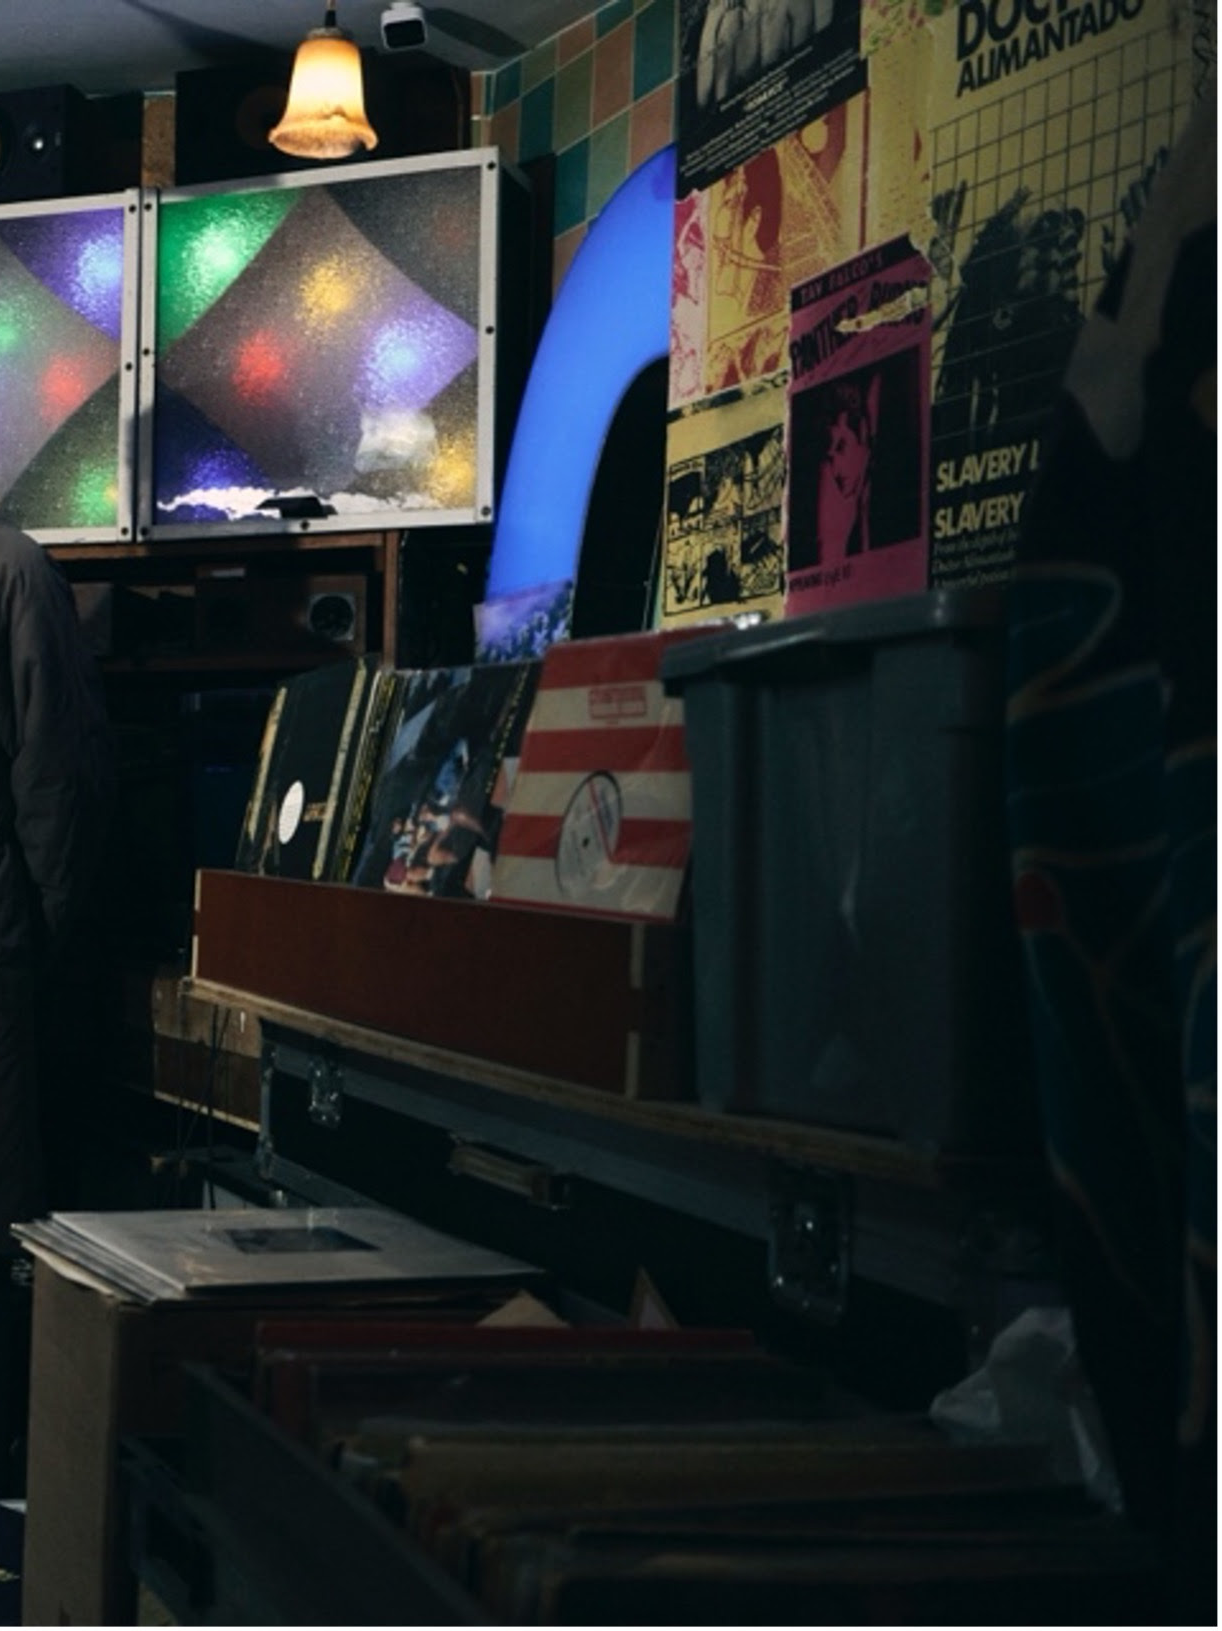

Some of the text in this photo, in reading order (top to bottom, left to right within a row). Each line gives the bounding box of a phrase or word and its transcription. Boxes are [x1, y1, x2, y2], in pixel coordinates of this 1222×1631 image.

[956, 0, 1144, 98] ALIMANTADO
[936, 442, 1027, 493] SLAVERY
[933, 491, 1025, 539] SLAVERY
